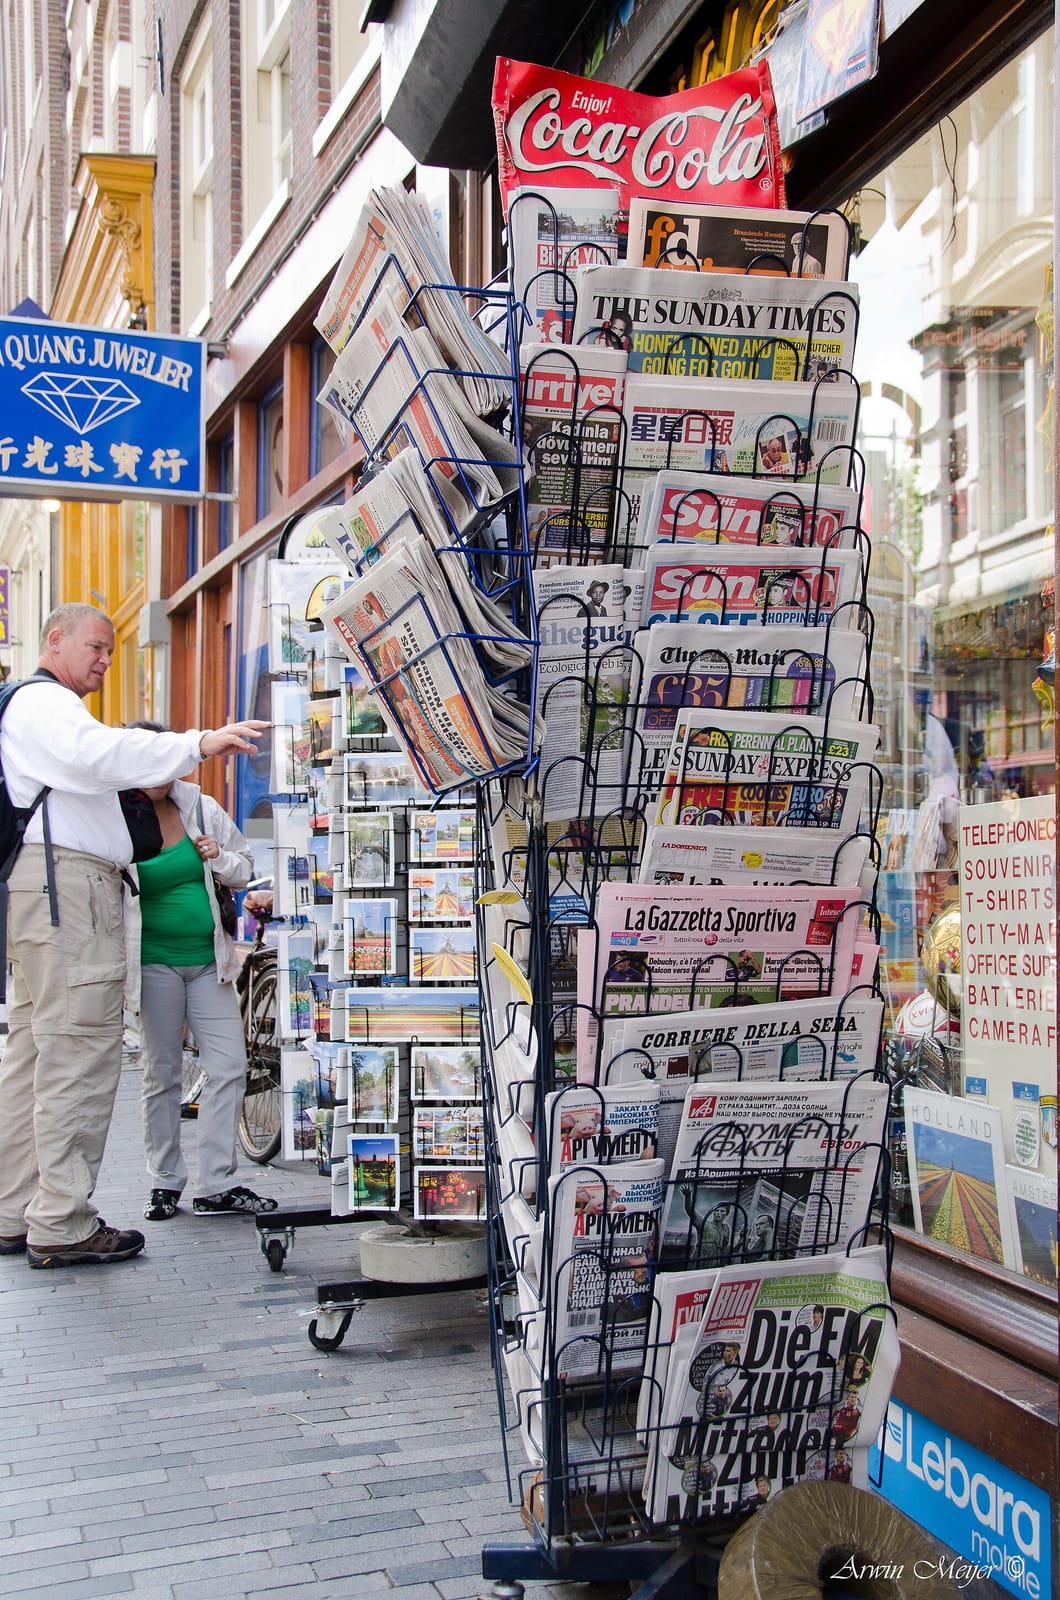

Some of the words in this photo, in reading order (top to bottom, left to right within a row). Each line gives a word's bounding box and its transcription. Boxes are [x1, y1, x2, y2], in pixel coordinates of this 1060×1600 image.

[571, 90, 613, 113] Enjoy!
[506, 87, 768, 190] Coca-Cola
[592, 295, 650, 323] THE
[653, 298, 764, 331] SUNDAY
[767, 305, 847, 334] TIMES
[740, 339, 772, 359] AND
[807, 342, 841, 354] UTCHER
[5, 334, 86, 371] QUANG
[88, 337, 193, 392] JUWELIER
[642, 355, 687, 376] GOING
[721, 360, 760, 380] GOLD
[630, 413, 735, 447] 星島日報
[714, 496, 738, 507] THE
[663, 492, 762, 535] Sun
[704, 566, 729, 575] THE
[654, 568, 756, 600] Sun
[760, 612, 816, 623] SHOPPING
[403, 621, 443, 709] Nederand
[538, 660, 591, 674] Ecologica
[660, 646, 696, 664] The
[735, 647, 788, 666] Mail
[709, 731, 732, 748] FREE
[733, 733, 785, 751] PERENNAL
[827, 744, 850, 757] £23
[684, 749, 761, 775] SUNDAY
[773, 755, 852, 781] EXPRESS
[681, 785, 738, 808] FREE
[792, 785, 824, 803] EURO
[964, 853, 1053, 881] SOUVENIR
[965, 886, 1054, 913] T-SHIRTS
[624, 907, 646, 931] La
[648, 904, 723, 932] Gazzetta
[724, 906, 797, 937] Sportiva
[670, 966, 690, 975] verso
[783, 966, 795, 974] non
[795, 966, 807, 975] può
[967, 953, 1018, 976] OFFICE
[604, 993, 713, 1013] PRANDELLI
[641, 1026, 738, 1050] CORRIERE
[745, 1020, 802, 1039] DELLA
[809, 1015, 858, 1034] SERA
[969, 1016, 1042, 1047] CAMERA
[615, 1105, 641, 1113] ЗАКАТ
[777, 1111, 805, 1119] ПОЧЕМУ
[603, 1117, 660, 1126] ОМПЕНСИРУЕ
[714, 1120, 860, 1140] АРГУМЕНТЫ
[911, 1104, 993, 1139] HOLLAND
[819, 1139, 869, 1151] ЕВРОПА
[712, 1280, 760, 1320] Bild
[718, 1317, 745, 1328] Sonntag
[742, 1307, 811, 1371] Die
[817, 1307, 884, 1370] EM
[730, 1369, 824, 1414] zum
[905, 1412, 1041, 1563] Lebara
[970, 1528, 1041, 1600] mobile
